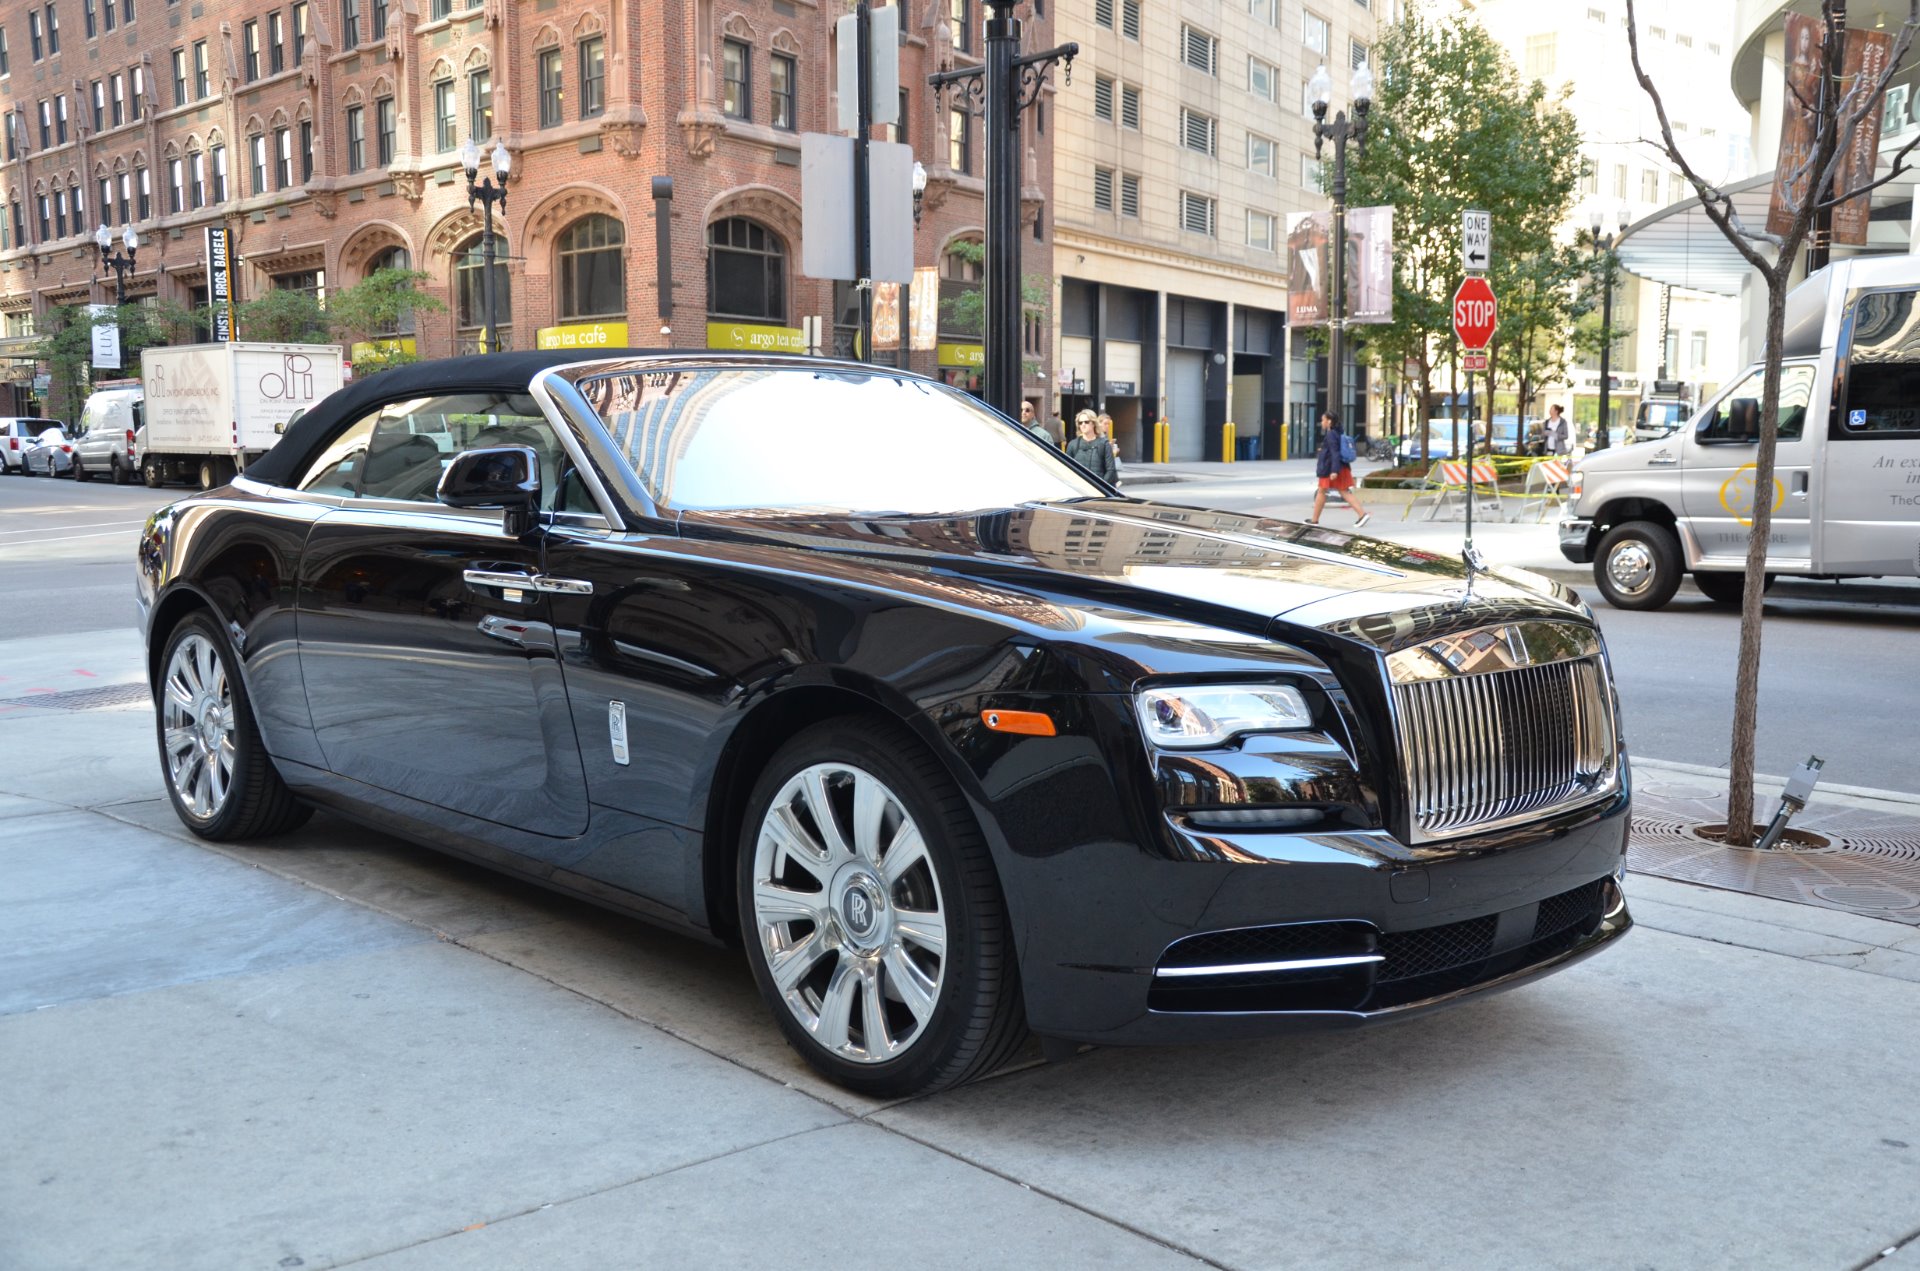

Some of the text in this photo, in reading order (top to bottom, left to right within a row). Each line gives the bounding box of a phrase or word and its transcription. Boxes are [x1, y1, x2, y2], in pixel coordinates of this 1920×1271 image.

[1466, 216, 1487, 231] ONE
[1466, 233, 1488, 247] WAY
[212, 230, 227, 267] BAGELS
[214, 270, 228, 296] BROS.
[1456, 300, 1495, 328] STOP
[562, 332, 577, 345] tea
[578, 325, 607, 345] café
[750, 333, 775, 349] argo
[776, 332, 789, 346] tea
[969, 352, 985, 364] arg
[1465, 356, 1486, 368] ALL WAY
[1872, 455, 1920, 469] An ex
[1717, 532, 1743, 543] THE
